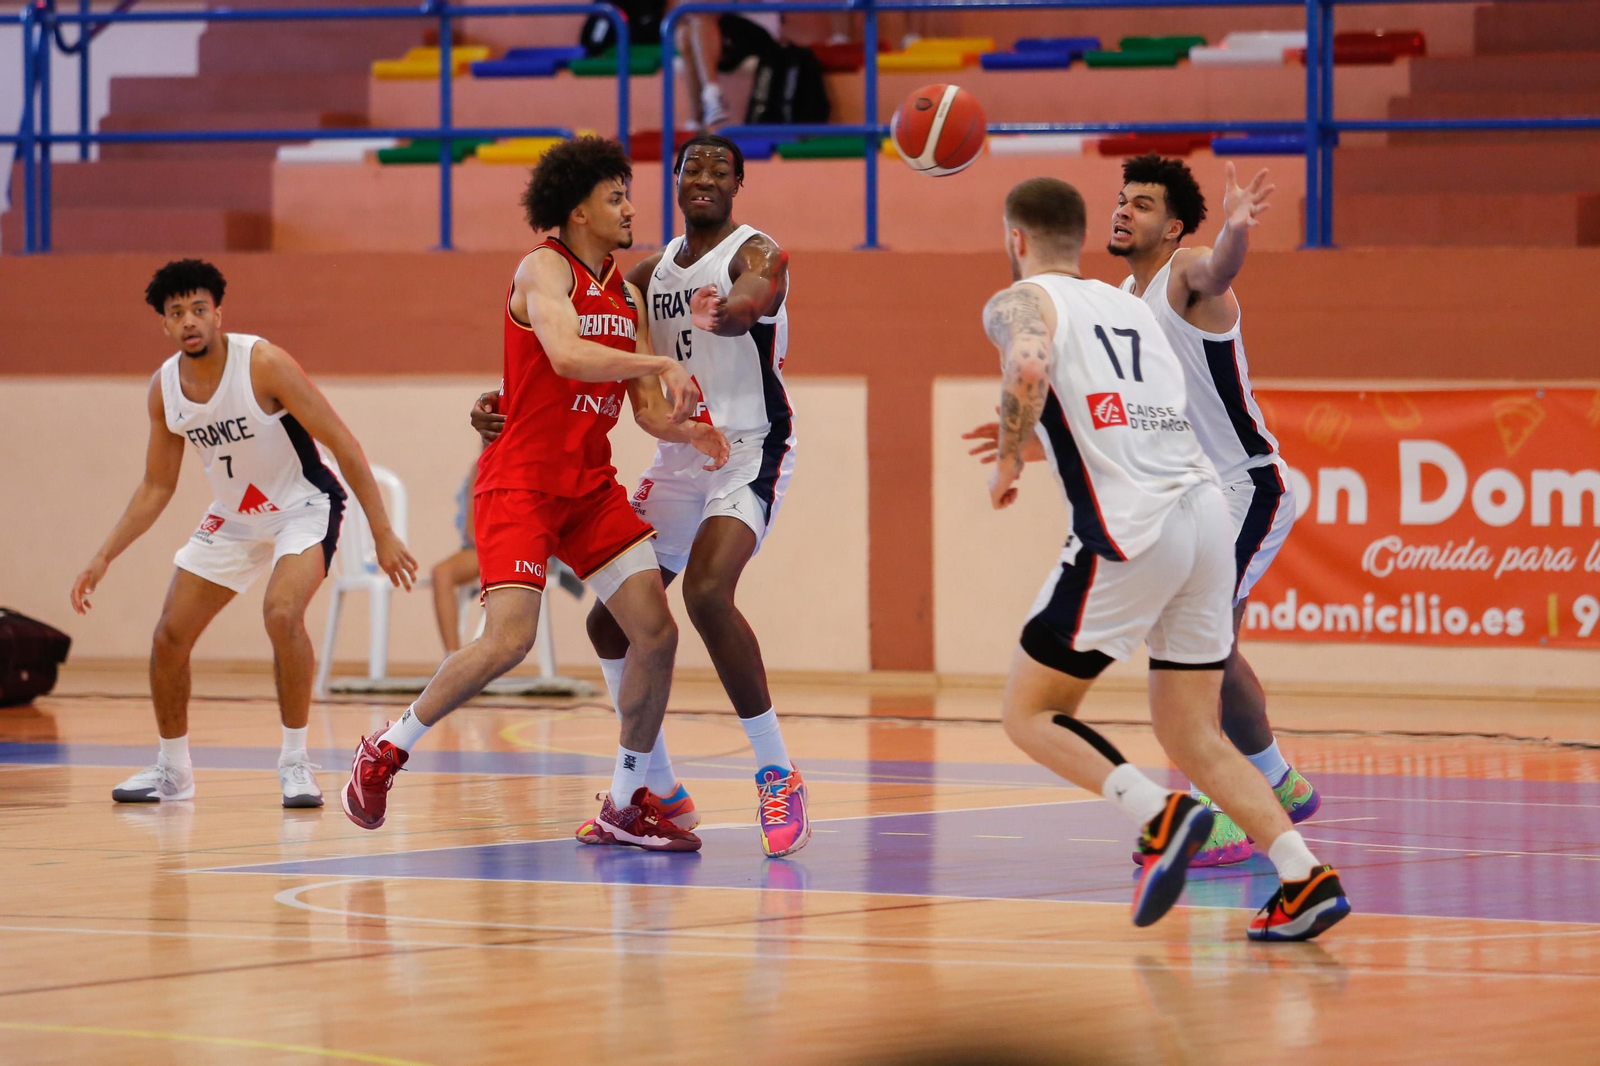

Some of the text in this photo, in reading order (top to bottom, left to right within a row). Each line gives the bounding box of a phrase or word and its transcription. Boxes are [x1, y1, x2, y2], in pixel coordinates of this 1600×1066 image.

[1093, 324, 1144, 382] 17
[1126, 403, 1177, 418] CAISSE
[186, 417, 254, 448] FRANCE
[219, 455, 233, 478] 7
[1399, 439, 1600, 527] Dom
[514, 560, 542, 577] ING
[1361, 535, 1494, 578] Comida
[1494, 545, 1577, 579] para
[1246, 588, 1525, 636] ndomicilio.es
